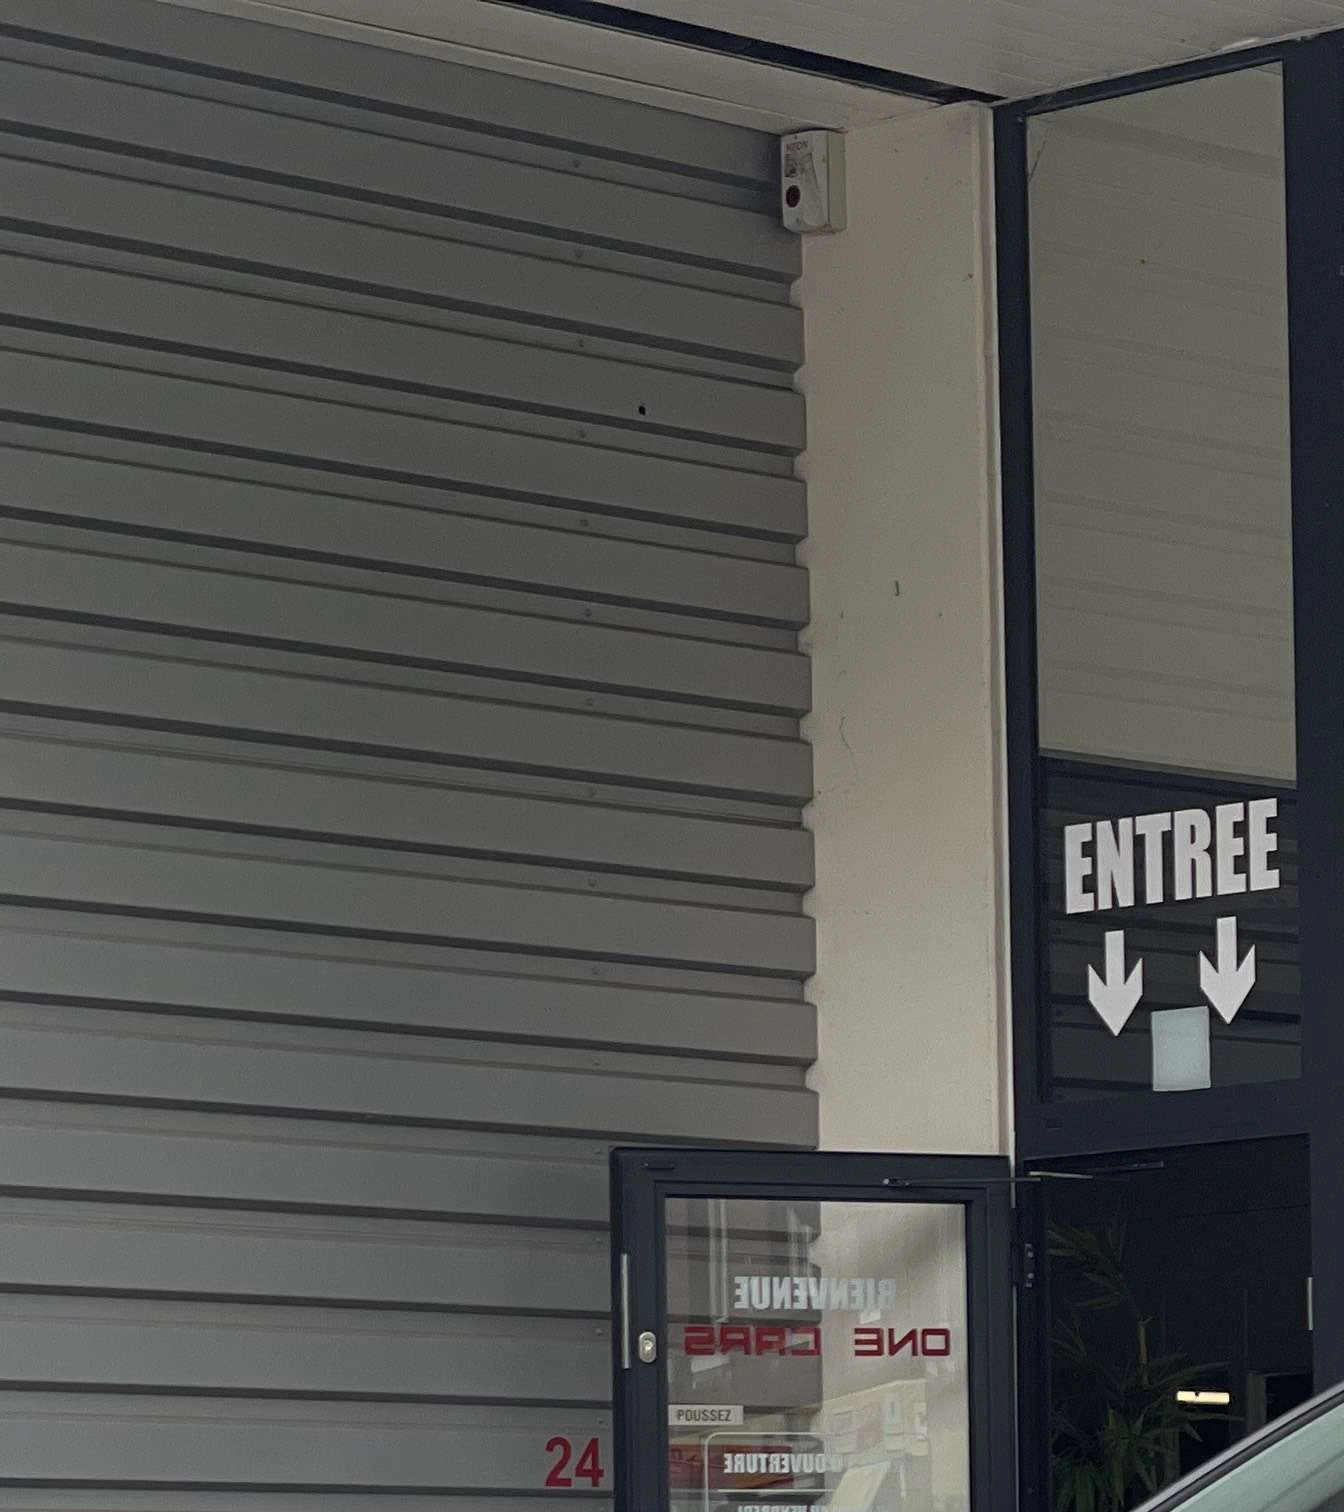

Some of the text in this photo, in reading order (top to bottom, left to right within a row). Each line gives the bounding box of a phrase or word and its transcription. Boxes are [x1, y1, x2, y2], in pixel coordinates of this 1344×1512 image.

[1064, 797, 1280, 915] ENTREE
[676, 1409, 732, 1423] POUSSEZ
[544, 1436, 605, 1488] 24
